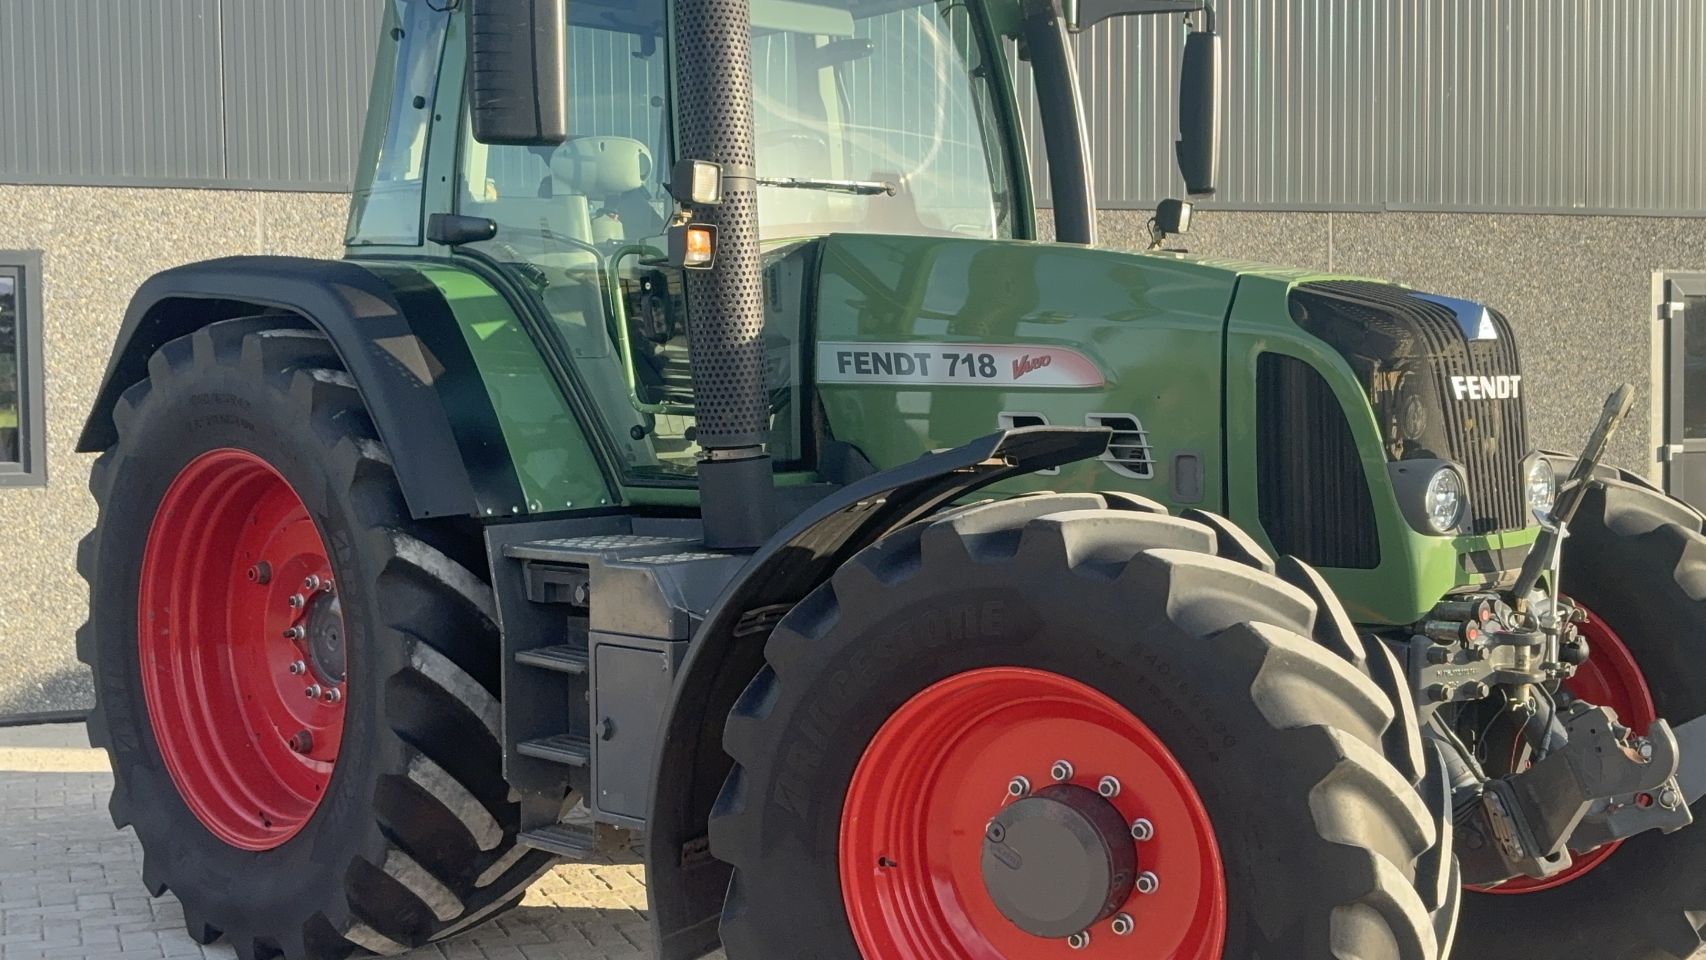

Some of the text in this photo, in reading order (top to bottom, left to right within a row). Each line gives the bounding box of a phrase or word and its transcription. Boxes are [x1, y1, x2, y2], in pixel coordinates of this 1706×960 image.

[836, 351, 931, 376] FENDT
[942, 353, 998, 378] 718
[1450, 375, 1521, 400] FENDT
